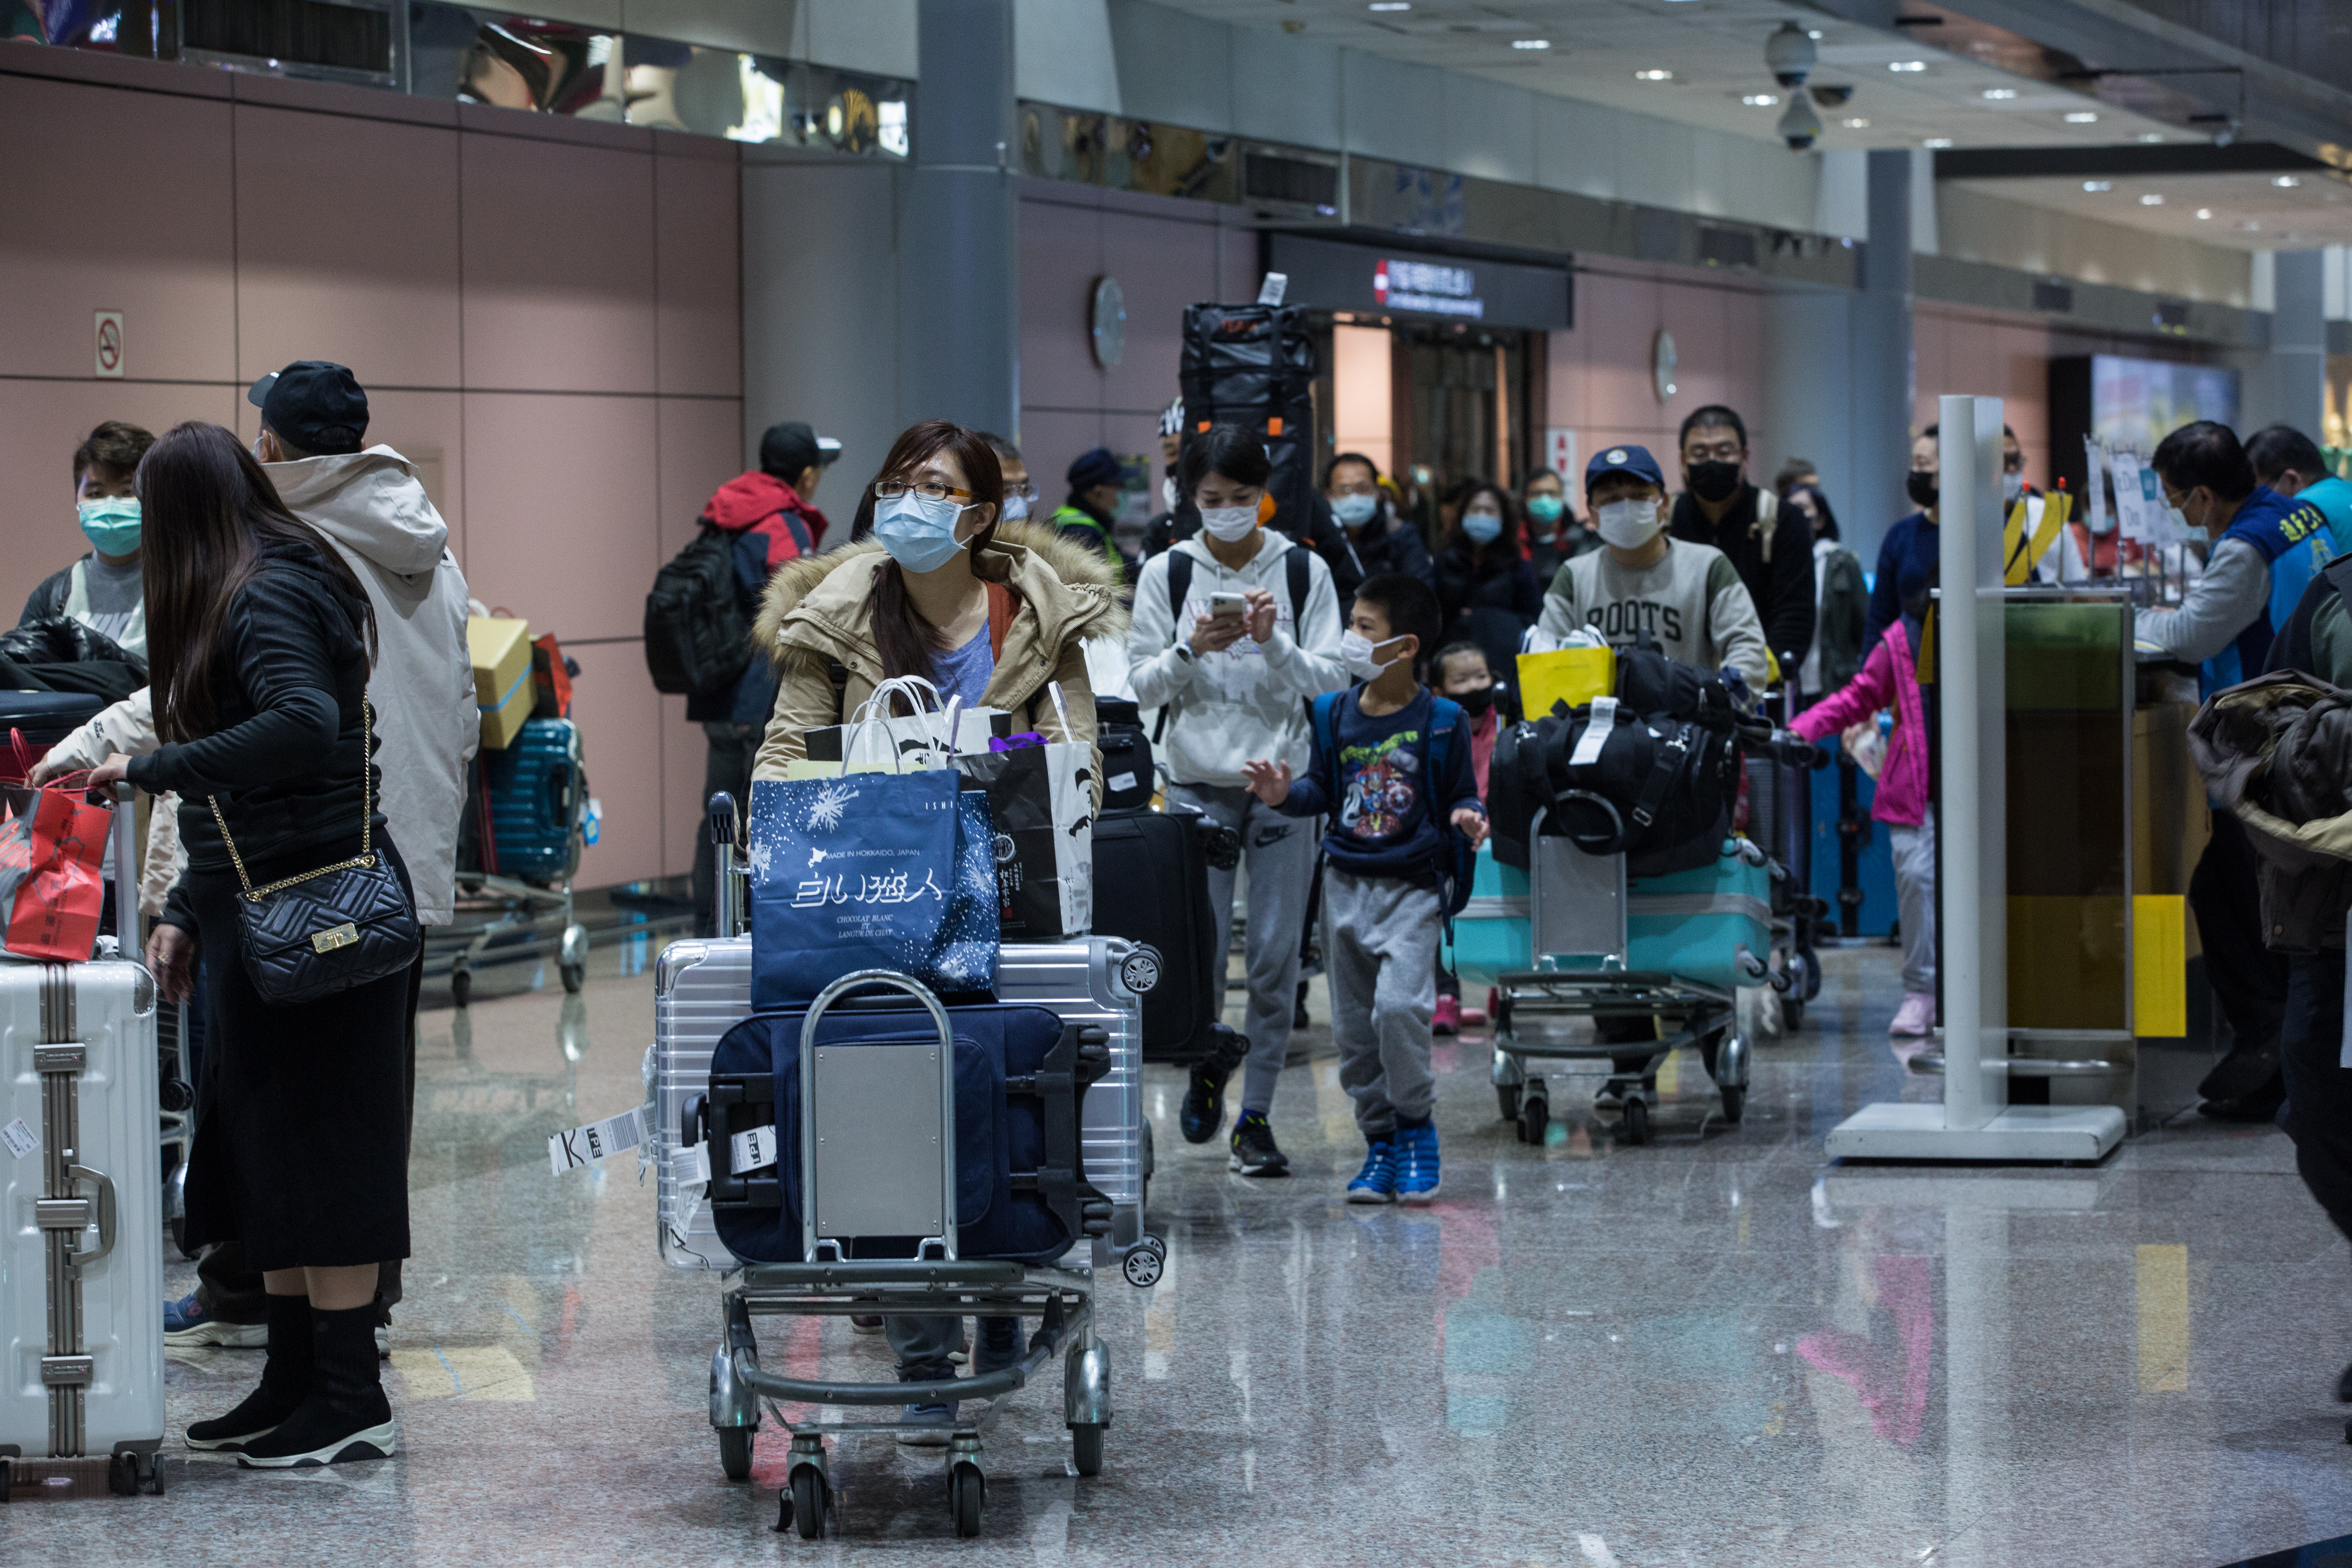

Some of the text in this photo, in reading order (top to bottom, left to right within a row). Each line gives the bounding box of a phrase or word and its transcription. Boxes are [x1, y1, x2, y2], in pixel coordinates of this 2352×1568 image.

[826, 851, 846, 859] MADE
[856, 849, 895, 857] HOKKAIDO,
[837, 914, 893, 924] CHOCOLAT BLANC
[838, 929, 864, 938] LANGUE
[875, 928, 893, 937] CHAT
[586, 1127, 603, 1158] TPE
[748, 1133, 760, 1164] TPE
